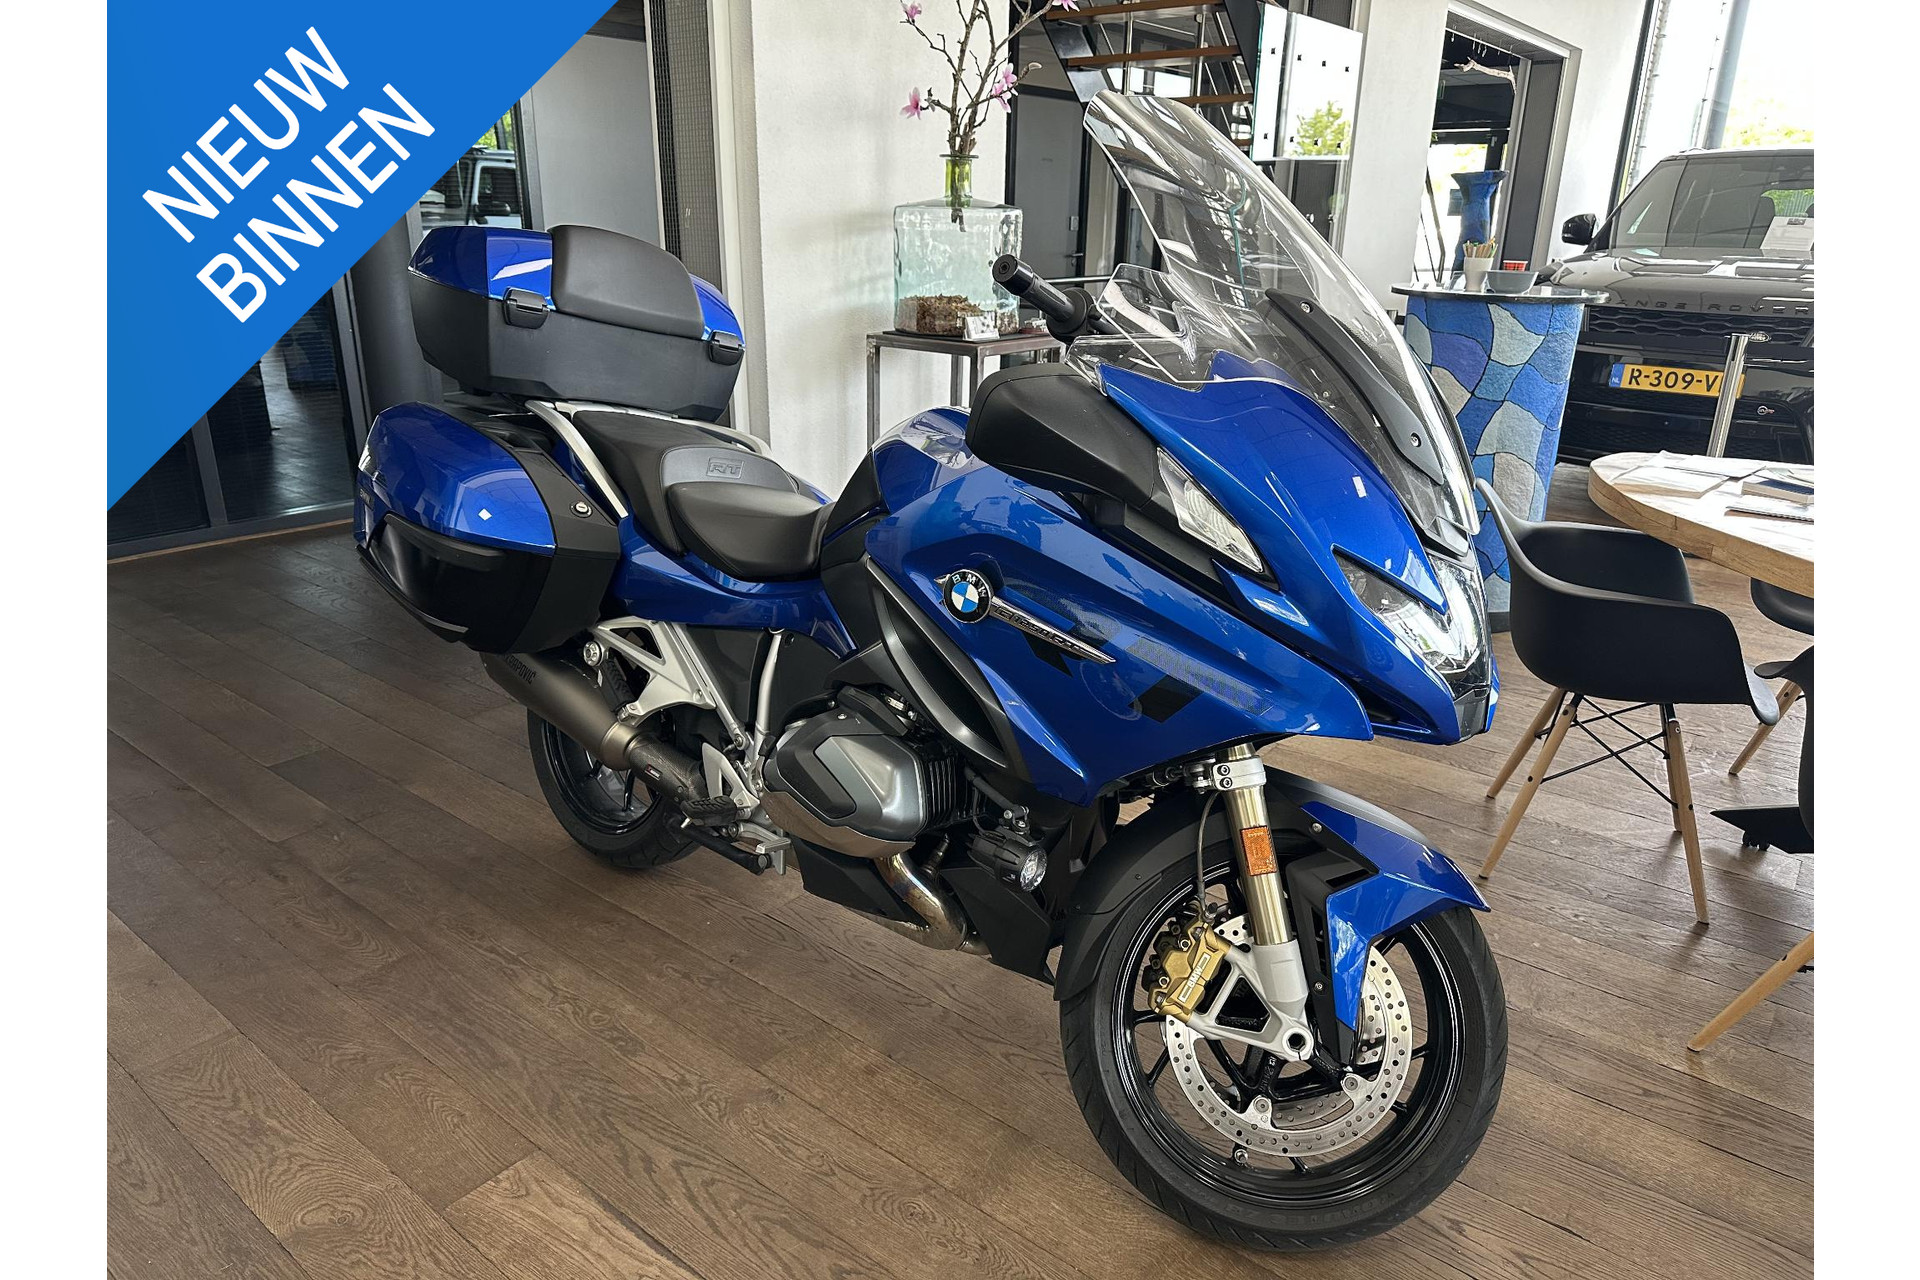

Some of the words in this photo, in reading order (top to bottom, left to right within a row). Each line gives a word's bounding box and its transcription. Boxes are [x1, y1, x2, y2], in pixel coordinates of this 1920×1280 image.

[1707, 302, 1809, 316] ROVER
[1628, 368, 1721, 393] R-309-V
[952, 573, 988, 598] BMW
[1187, 965, 1204, 988] BMW
